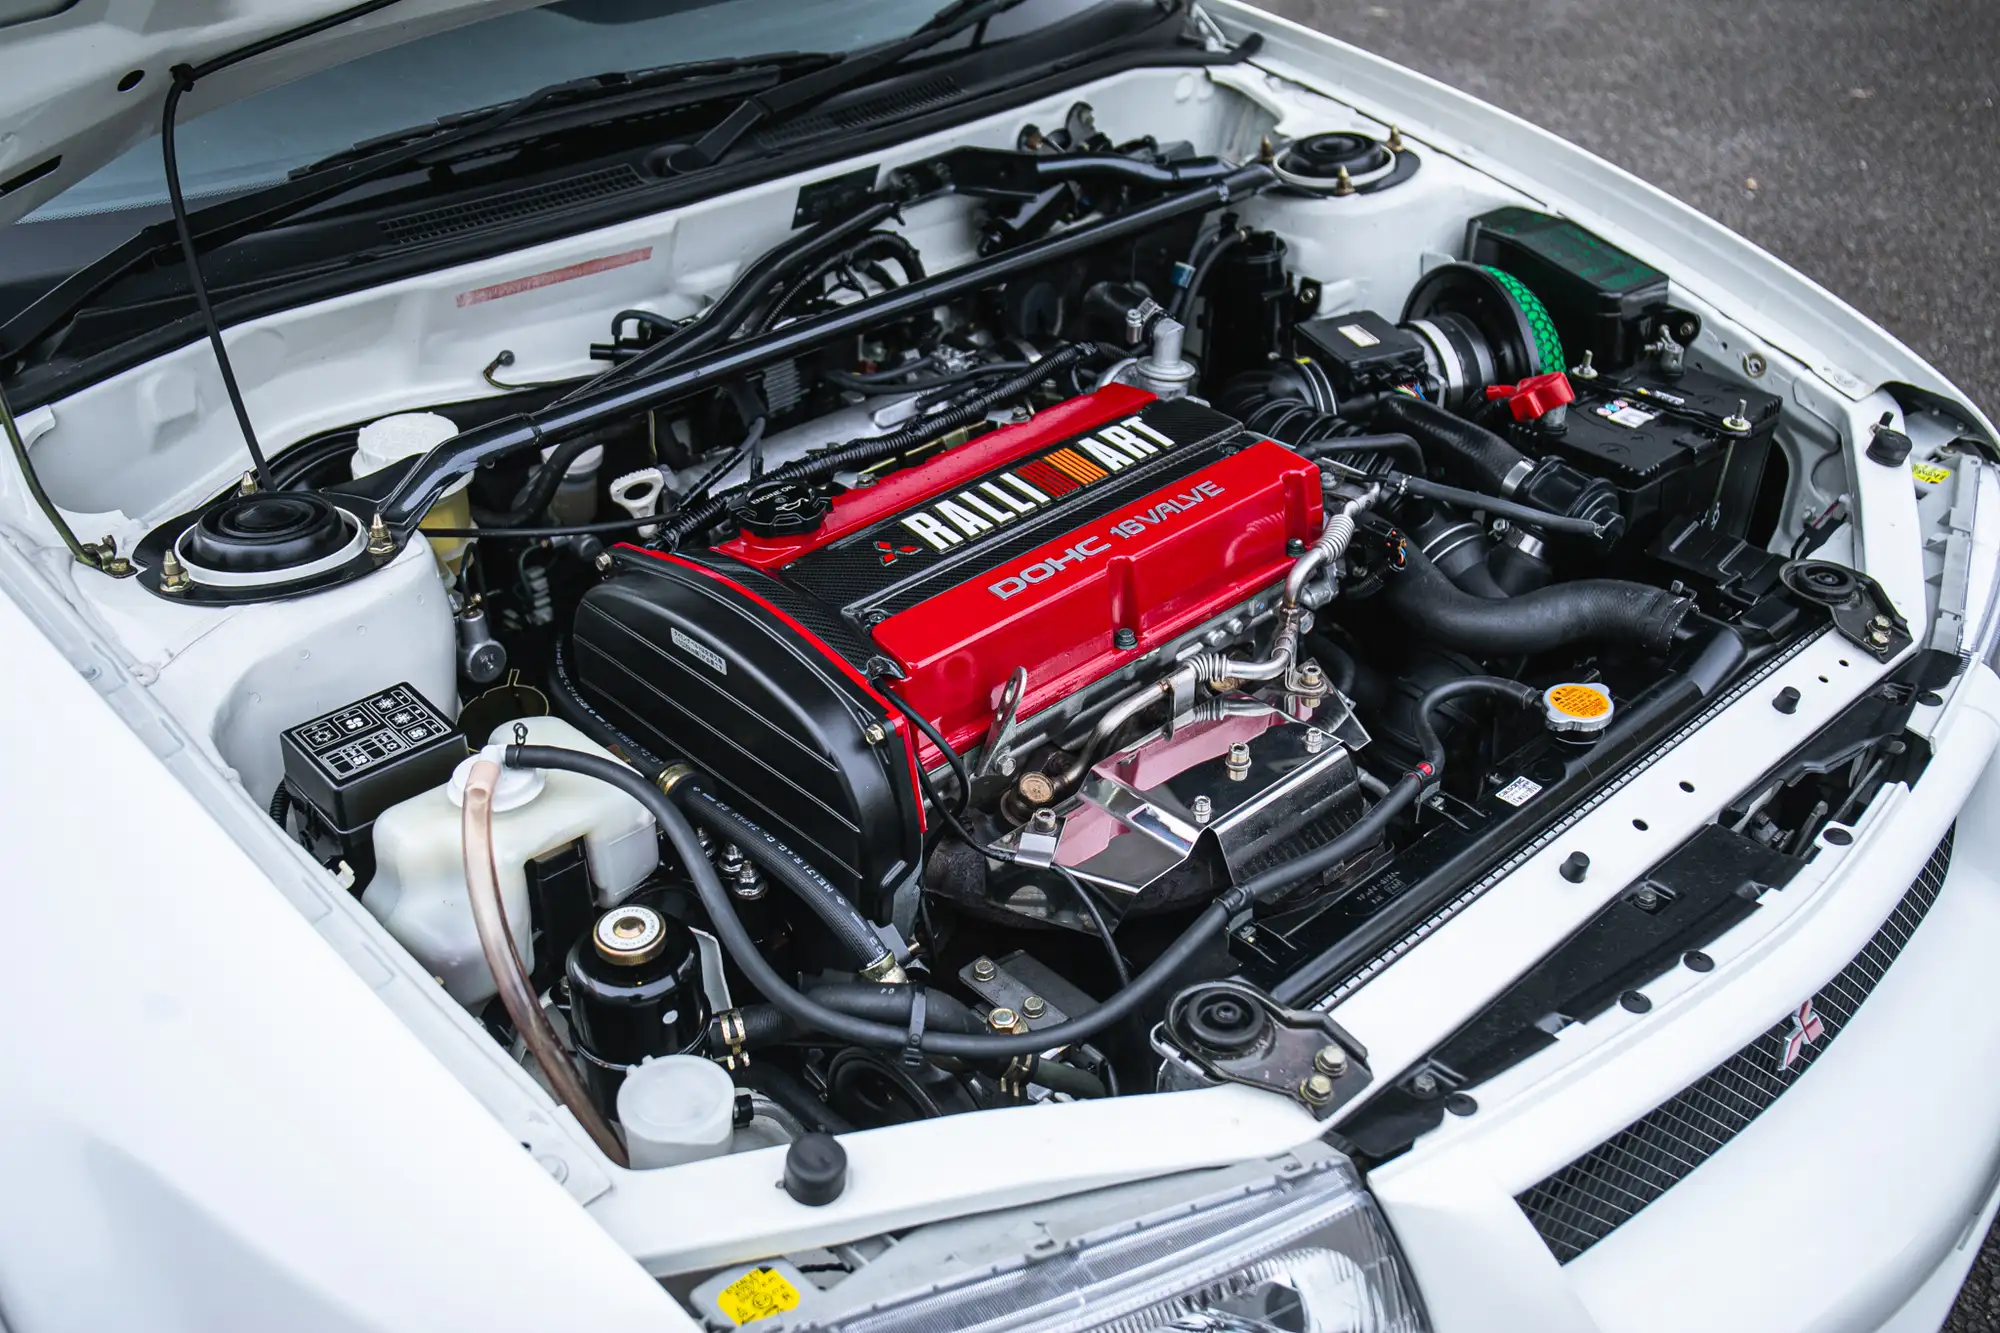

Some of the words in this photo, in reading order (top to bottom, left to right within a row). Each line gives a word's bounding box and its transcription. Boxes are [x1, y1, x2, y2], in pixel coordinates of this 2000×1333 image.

[751, 490, 782, 504] ENGINE
[899, 471, 1052, 553] RALLI
[1074, 415, 1177, 473] ART
[988, 535, 1112, 600] DOHC
[731, 812, 760, 831] JAPAN
[803, 866, 834, 893] MEIJI
